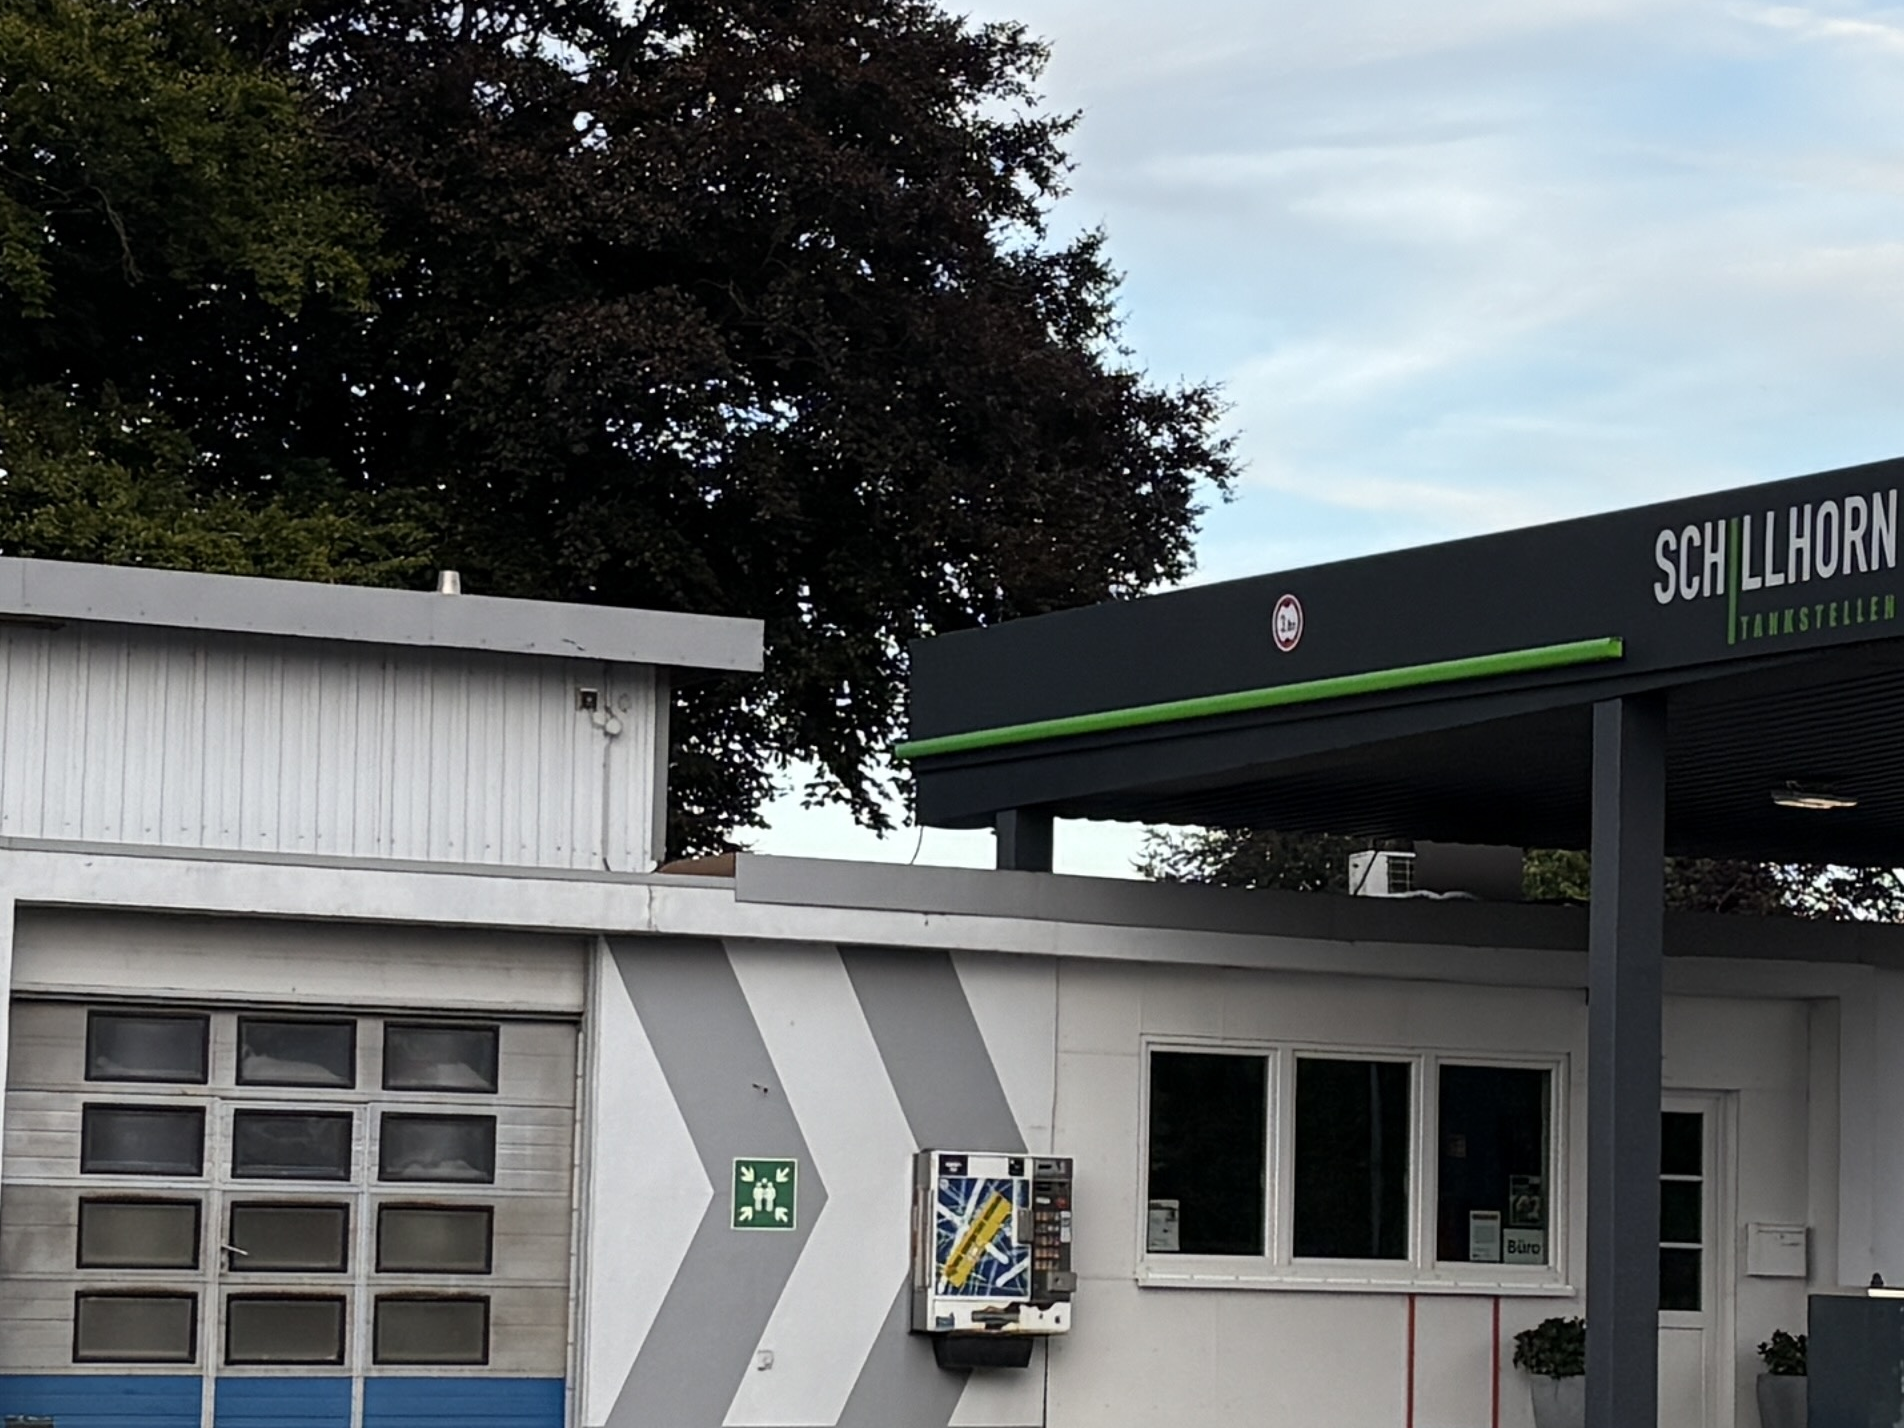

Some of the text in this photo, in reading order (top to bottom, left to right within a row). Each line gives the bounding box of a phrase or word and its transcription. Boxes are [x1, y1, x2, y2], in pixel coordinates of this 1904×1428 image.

[1654, 489, 1897, 645] SCHILLHORN
[1741, 595, 1895, 640] TANKSTELLEN
[1507, 1239, 1541, 1254] Büro
